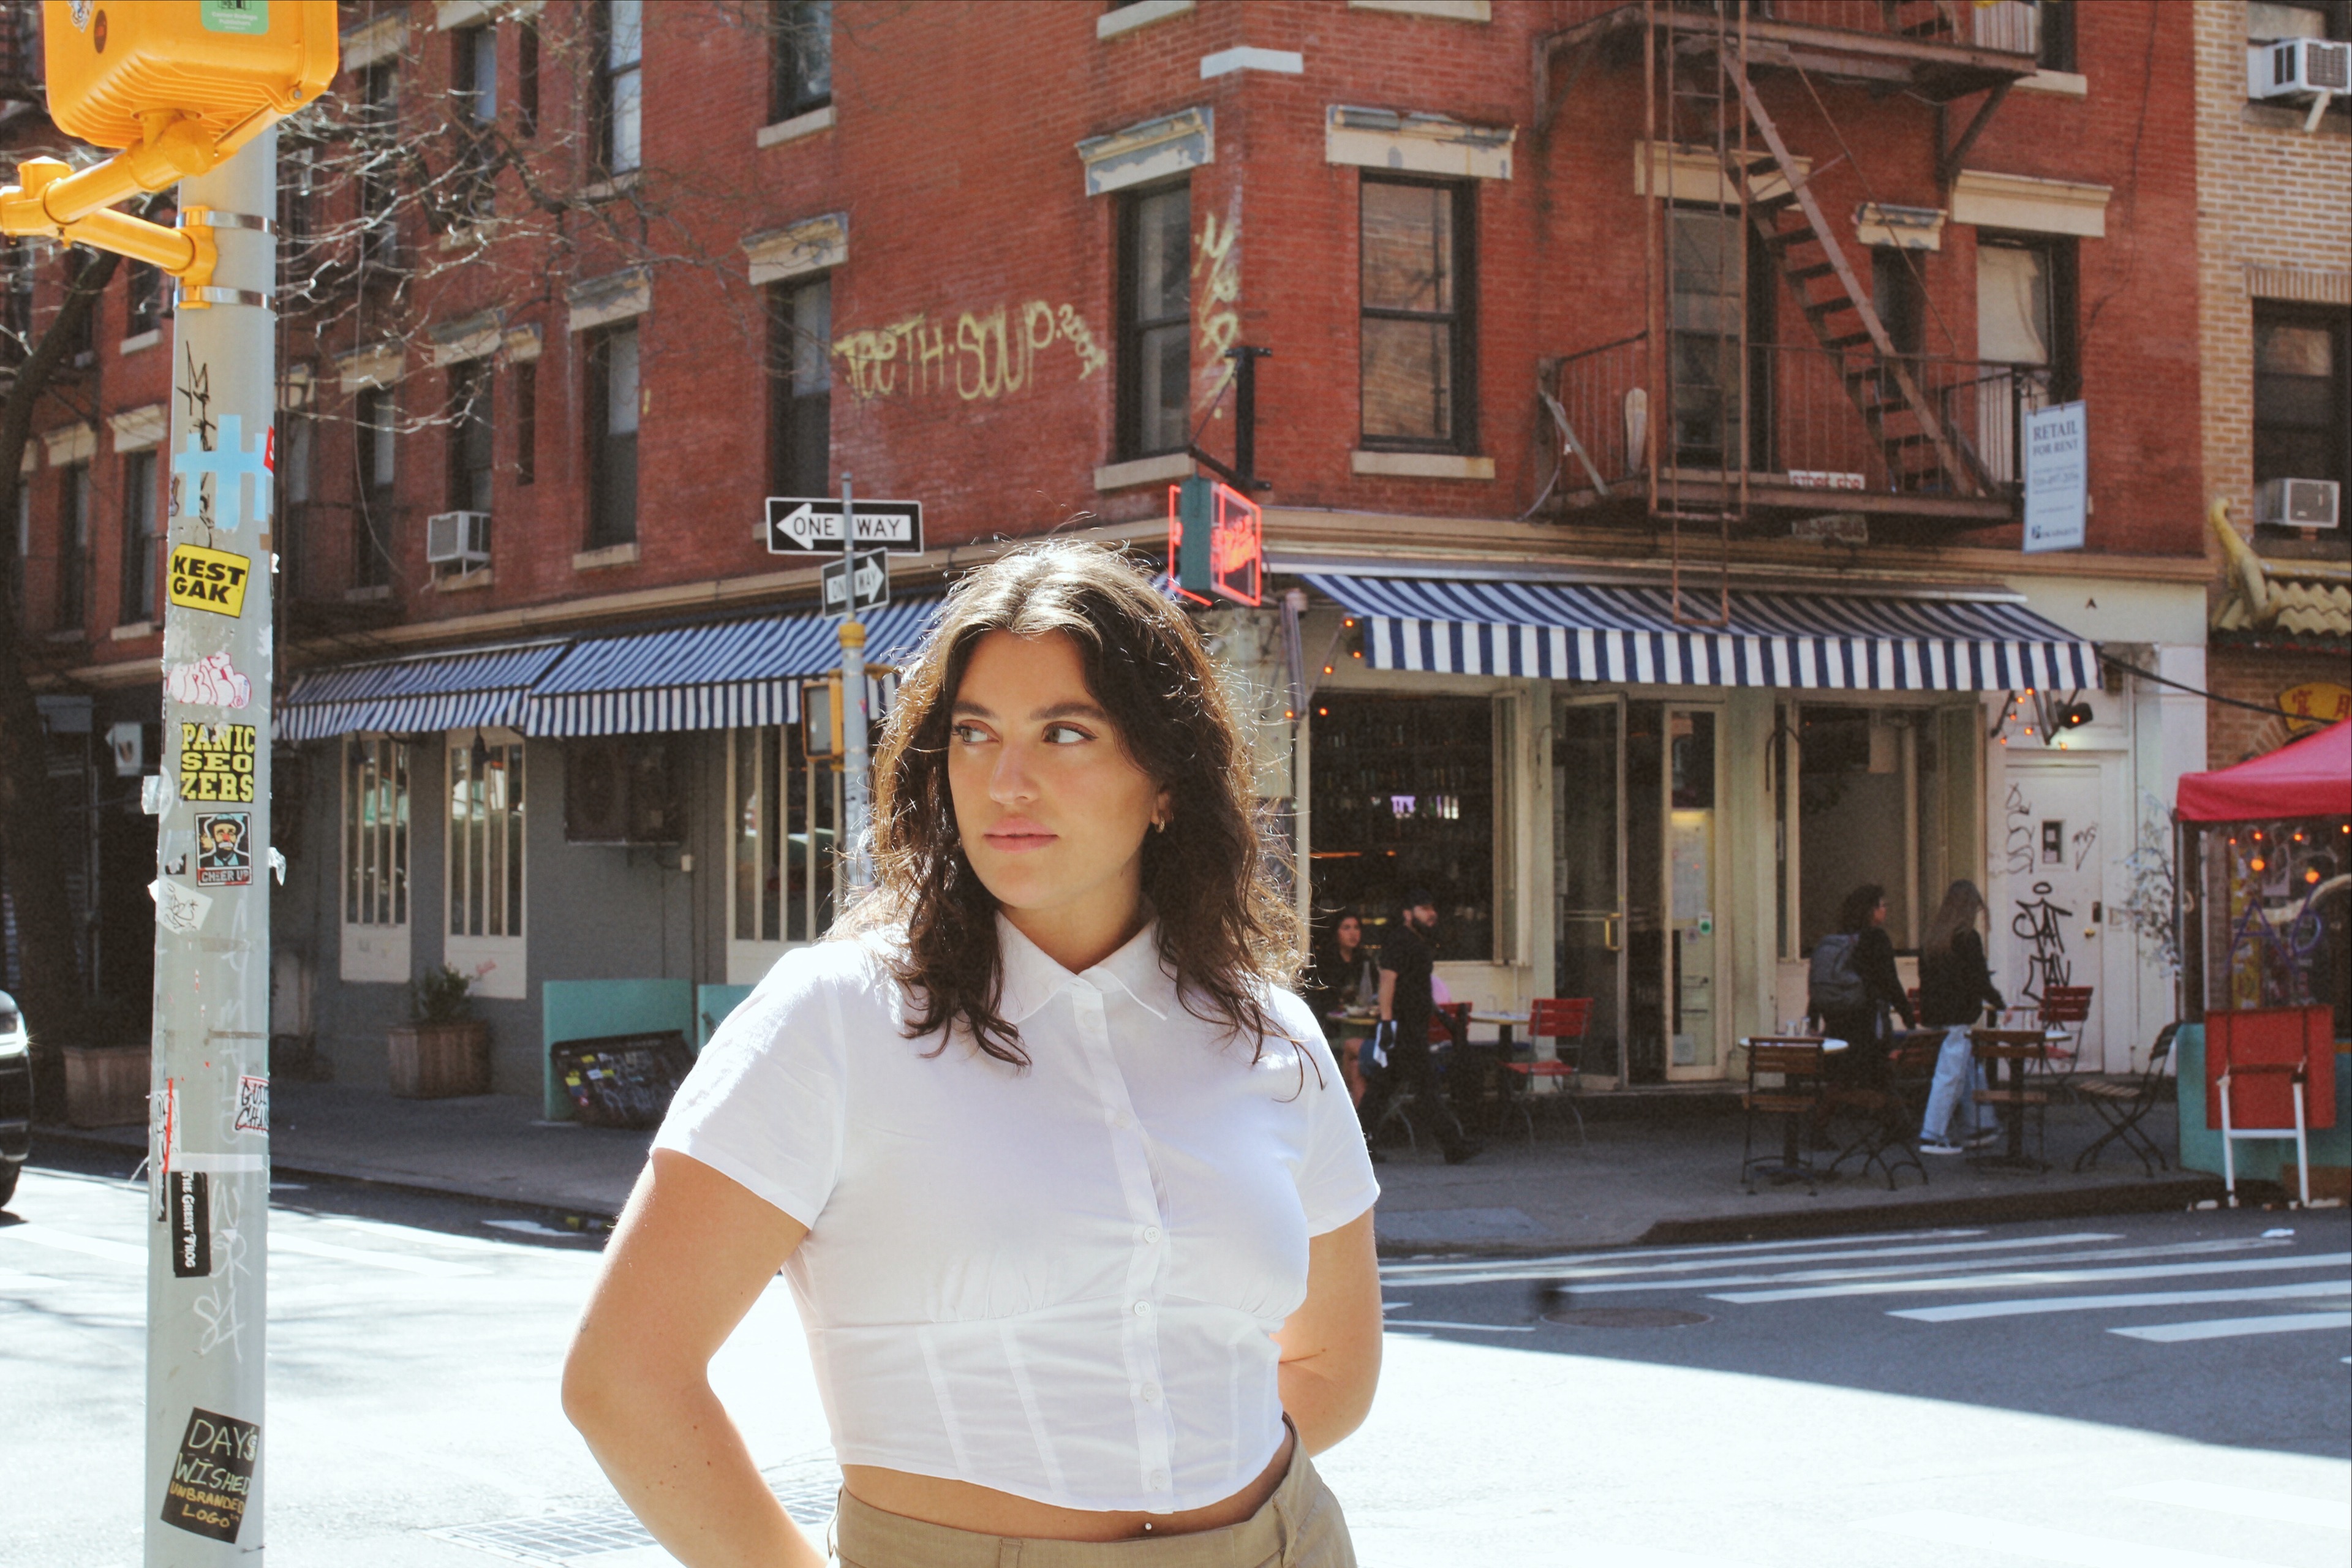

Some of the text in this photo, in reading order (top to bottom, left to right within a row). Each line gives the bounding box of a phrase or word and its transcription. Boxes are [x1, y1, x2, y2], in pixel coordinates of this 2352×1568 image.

[2033, 420, 2078, 442] RETAIL
[2033, 439, 2078, 456] FOR RENT
[794, 517, 901, 538] ONE WAY
[173, 555, 246, 586] KEST
[832, 569, 877, 600] ON WAY
[173, 576, 232, 605] GAK
[181, 723, 255, 753] PANIC
[181, 752, 253, 772] SEO
[181, 771, 254, 802] ZERS
[201, 869, 249, 882] CHEER UP
[174, 1452, 252, 1495] WISHED
[169, 1481, 246, 1515] UNBRANDED
[181, 1504, 230, 1528] LOGO
